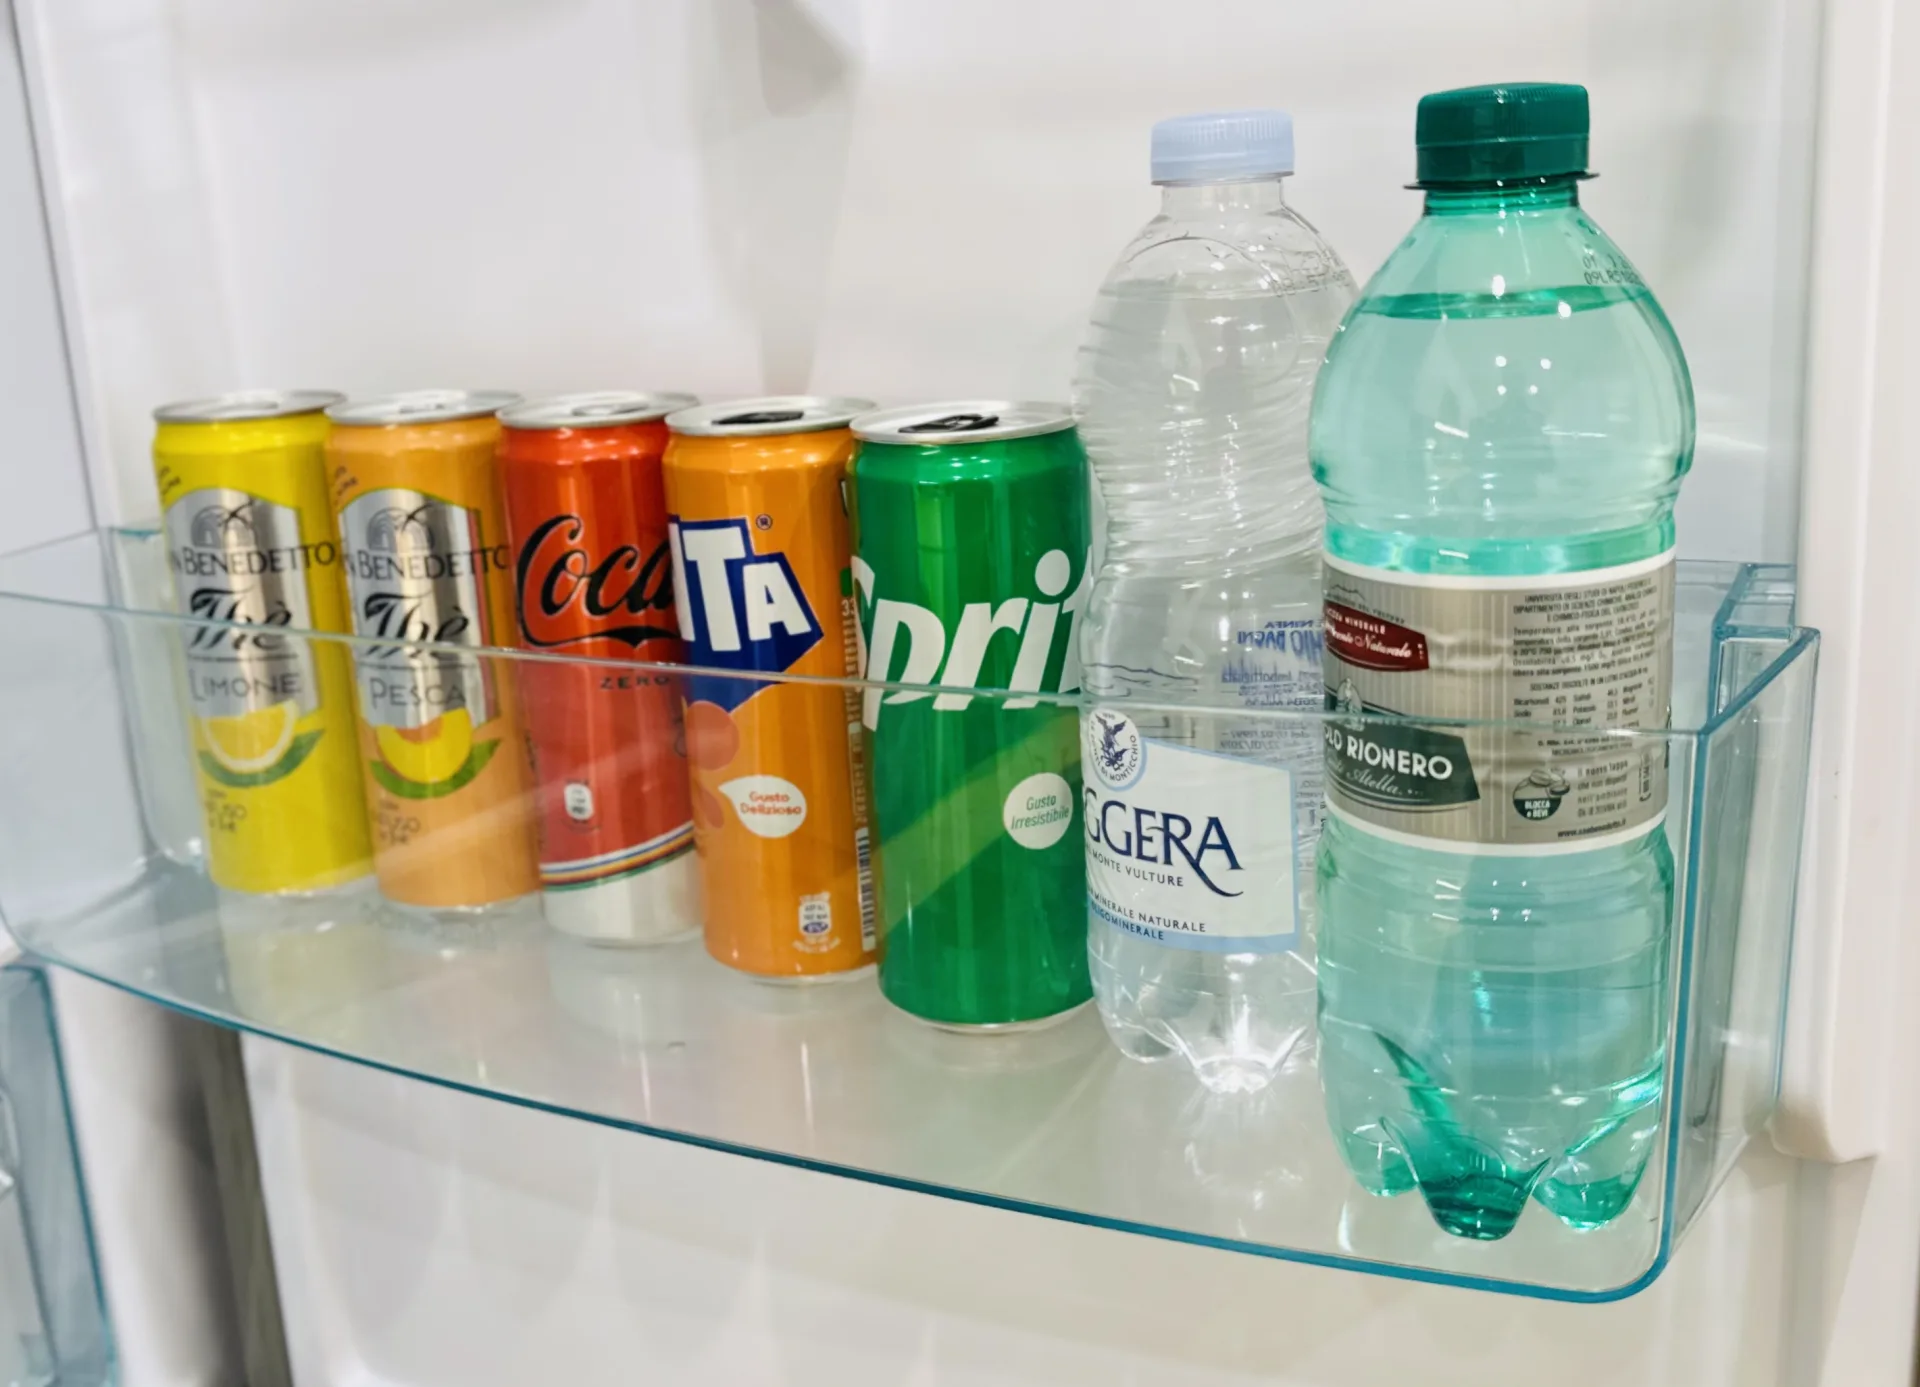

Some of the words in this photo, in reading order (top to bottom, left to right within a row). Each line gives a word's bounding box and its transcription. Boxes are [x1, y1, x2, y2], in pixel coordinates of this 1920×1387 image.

[182, 541, 336, 577] BENEDETTO
[517, 514, 676, 648] Coca
[188, 668, 302, 702] LIMONE
[369, 676, 467, 710] PESCA
[601, 675, 671, 690] ZERO
[1346, 734, 1454, 780] RIONERO
[740, 803, 803, 816] Delizioso
[749, 790, 790, 804] Gusto
[1026, 794, 1057, 811] Gusto
[1010, 806, 1070, 830] Irresistibile
[1084, 787, 1246, 898] GGERA
[1092, 849, 1122, 873] MONTE
[1125, 866, 1184, 887] VULTURE
[1094, 891, 1134, 919] MINERALE
[1138, 912, 1207, 933] NATURALE
